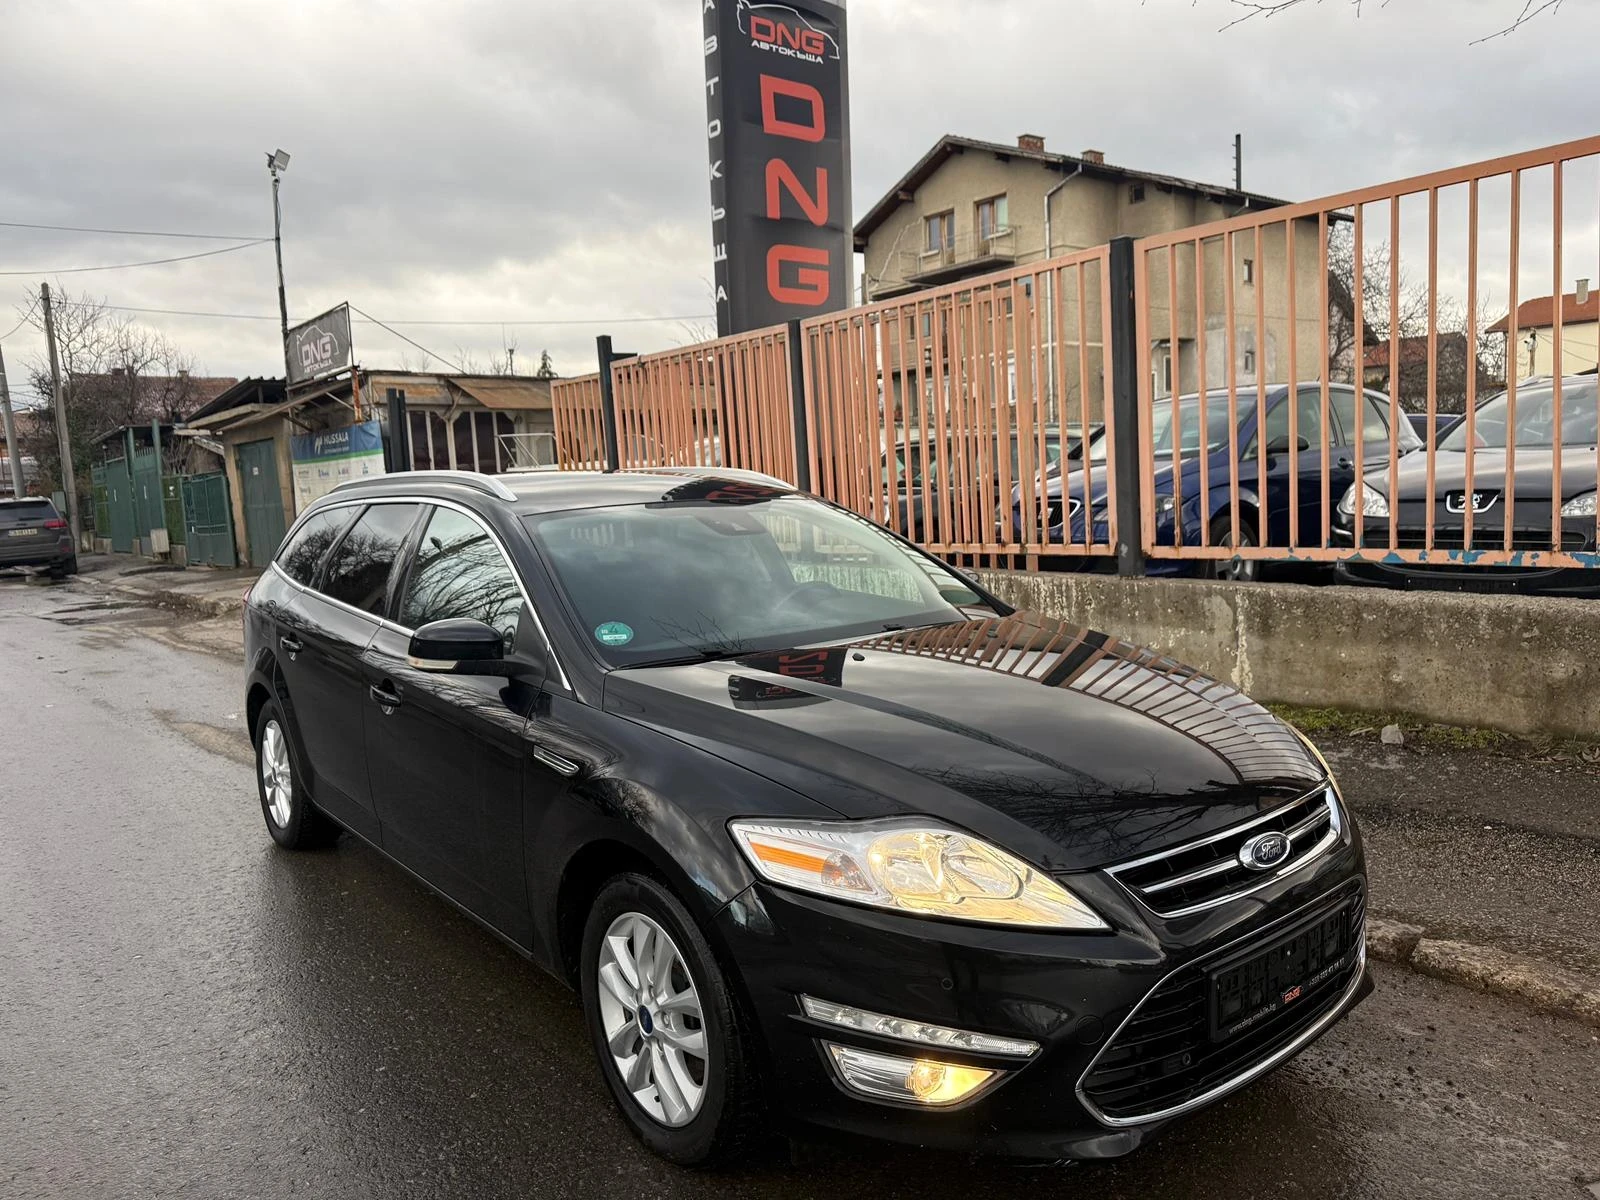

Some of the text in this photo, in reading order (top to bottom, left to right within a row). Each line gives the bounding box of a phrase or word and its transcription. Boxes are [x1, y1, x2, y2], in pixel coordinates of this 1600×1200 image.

[750, 15, 825, 56] DNG
[760, 73, 829, 306] DNG
[302, 335, 332, 367] DNG
[1261, 839, 1282, 861] Ford
